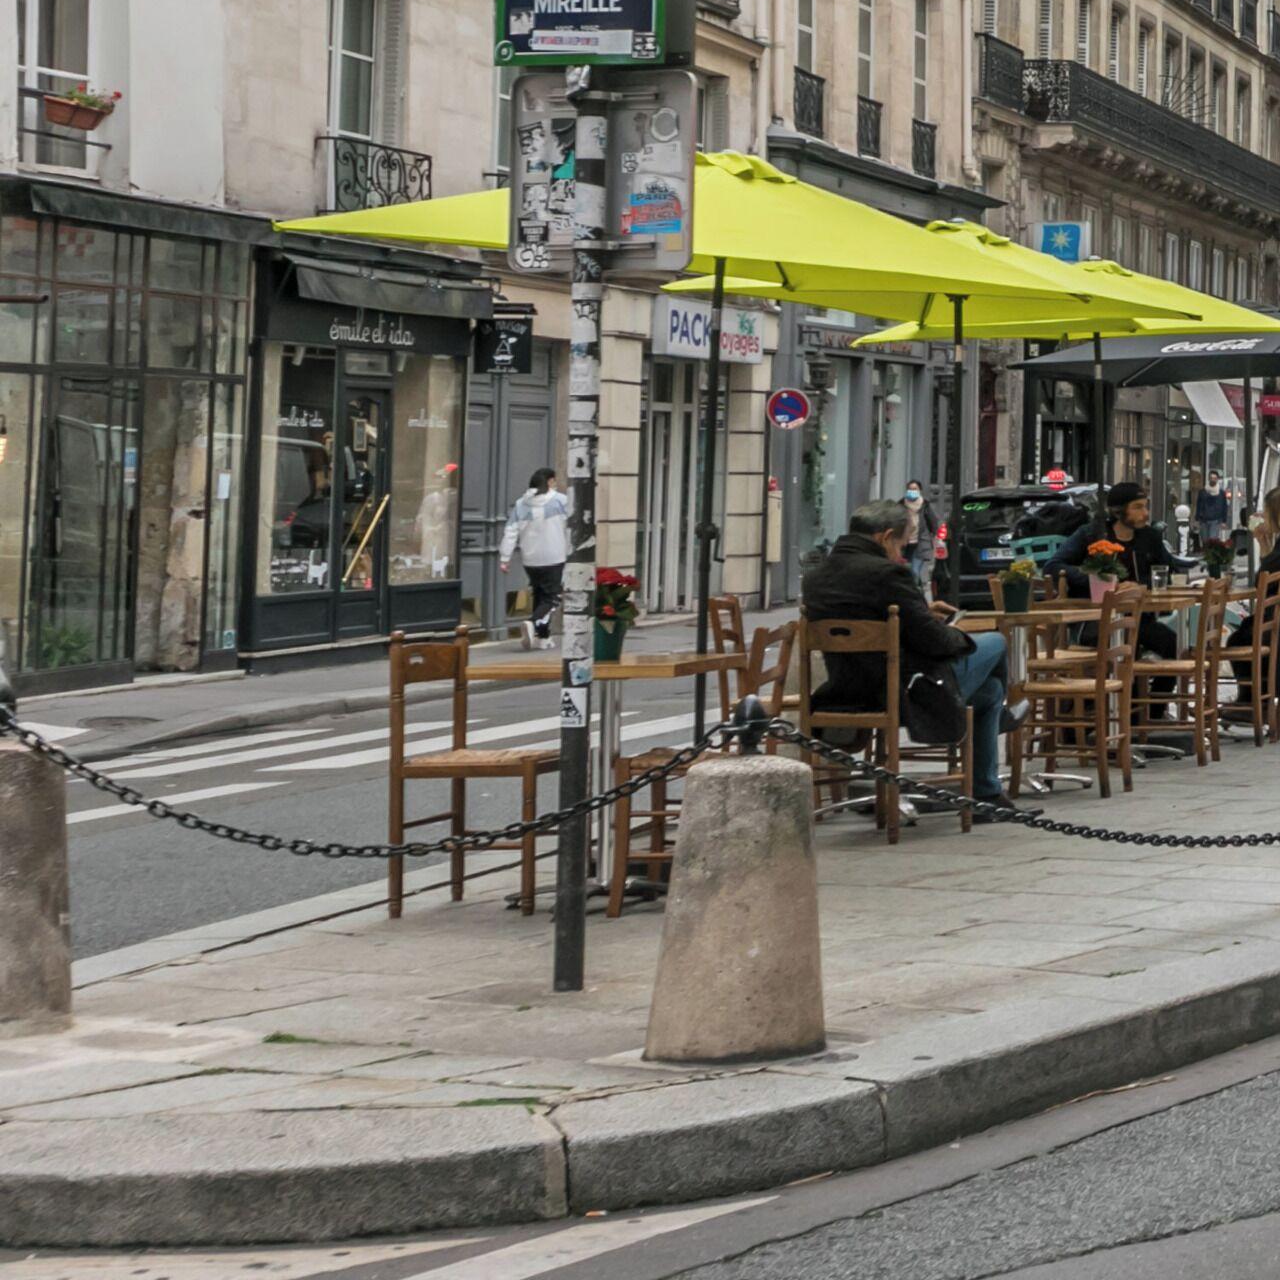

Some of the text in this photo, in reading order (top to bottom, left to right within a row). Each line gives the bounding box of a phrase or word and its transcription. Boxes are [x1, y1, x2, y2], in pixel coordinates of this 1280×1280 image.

[329, 308, 416, 346] émile et ida
[670, 310, 713, 347] PACK
[720, 331, 760, 357] oyages
